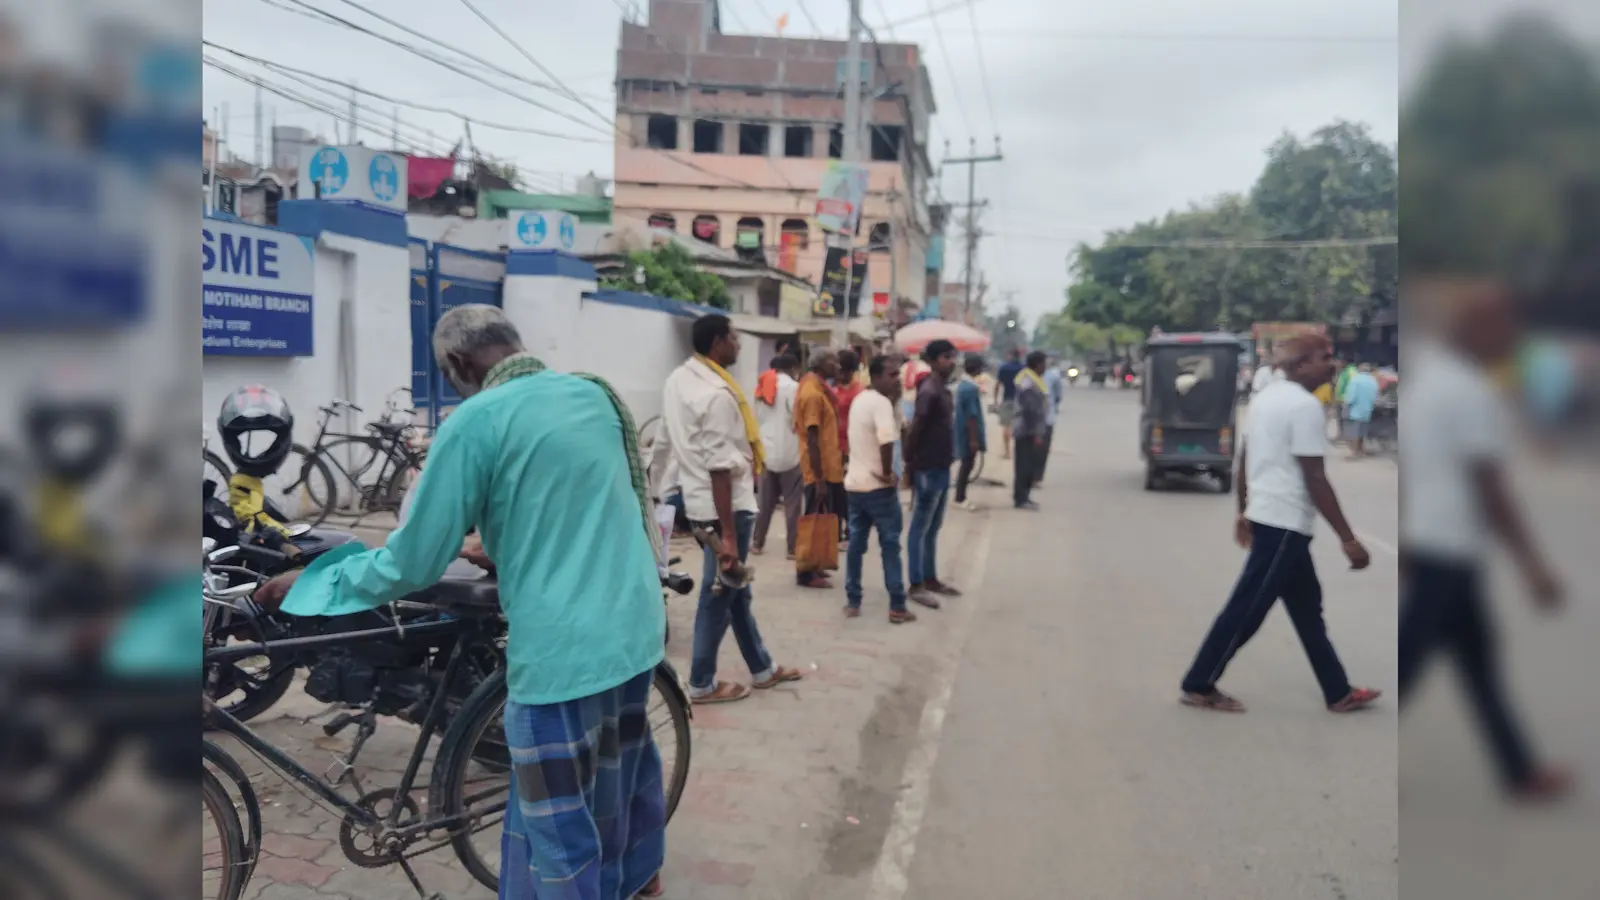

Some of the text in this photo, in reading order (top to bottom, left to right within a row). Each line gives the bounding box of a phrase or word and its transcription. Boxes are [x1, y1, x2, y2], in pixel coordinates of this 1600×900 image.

[204, 290, 309, 313] MOTIHARI BRANCH
[232, 336, 287, 350] Enterprises
